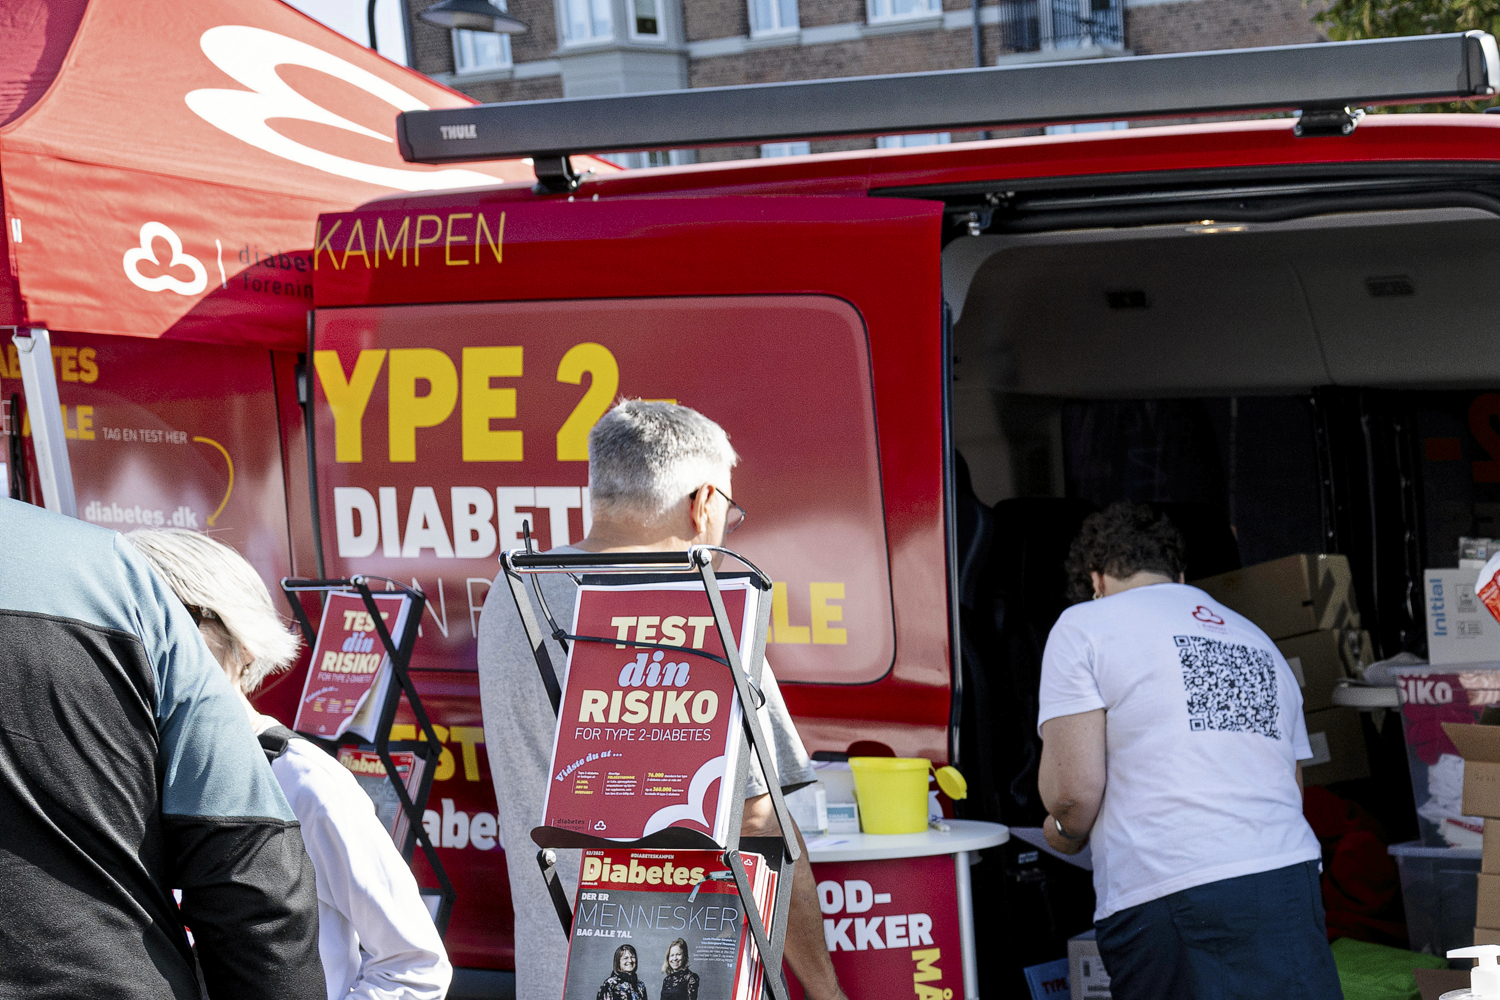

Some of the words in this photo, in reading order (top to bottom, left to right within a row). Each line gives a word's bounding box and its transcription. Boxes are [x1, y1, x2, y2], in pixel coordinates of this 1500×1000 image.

[440, 124, 478, 140] THULE
[314, 211, 506, 271] KAMPEN
[312, 348, 525, 463] YPE
[102, 427, 122, 441] TAG
[123, 429, 138, 443] EN
[139, 429, 163, 444] TEST
[165, 431, 188, 445] HER
[85, 501, 199, 528] diabetes.dk
[1429, 577, 1448, 637] Initial
[342, 631, 375, 653] din
[610, 616, 715, 649] TEST
[320, 650, 381, 674] RISIKO
[617, 650, 691, 688] din
[578, 690, 719, 724] RISIKO
[574, 727, 601, 742] FOR
[604, 728, 636, 742] TYPE
[638, 728, 712, 742] 2-DIABETES
[555, 757, 586, 782] Vidste
[585, 752, 600, 763] du
[600, 749, 612, 759] at
[416, 798, 505, 851] abe
[581, 856, 706, 887] Diabetes
[581, 892, 598, 901] DER
[599, 893, 609, 901] ER
[577, 902, 739, 932] MENNESKER
[576, 928, 592, 937] BAG
[594, 930, 616, 938] ALLE
[617, 930, 632, 939] TAL
